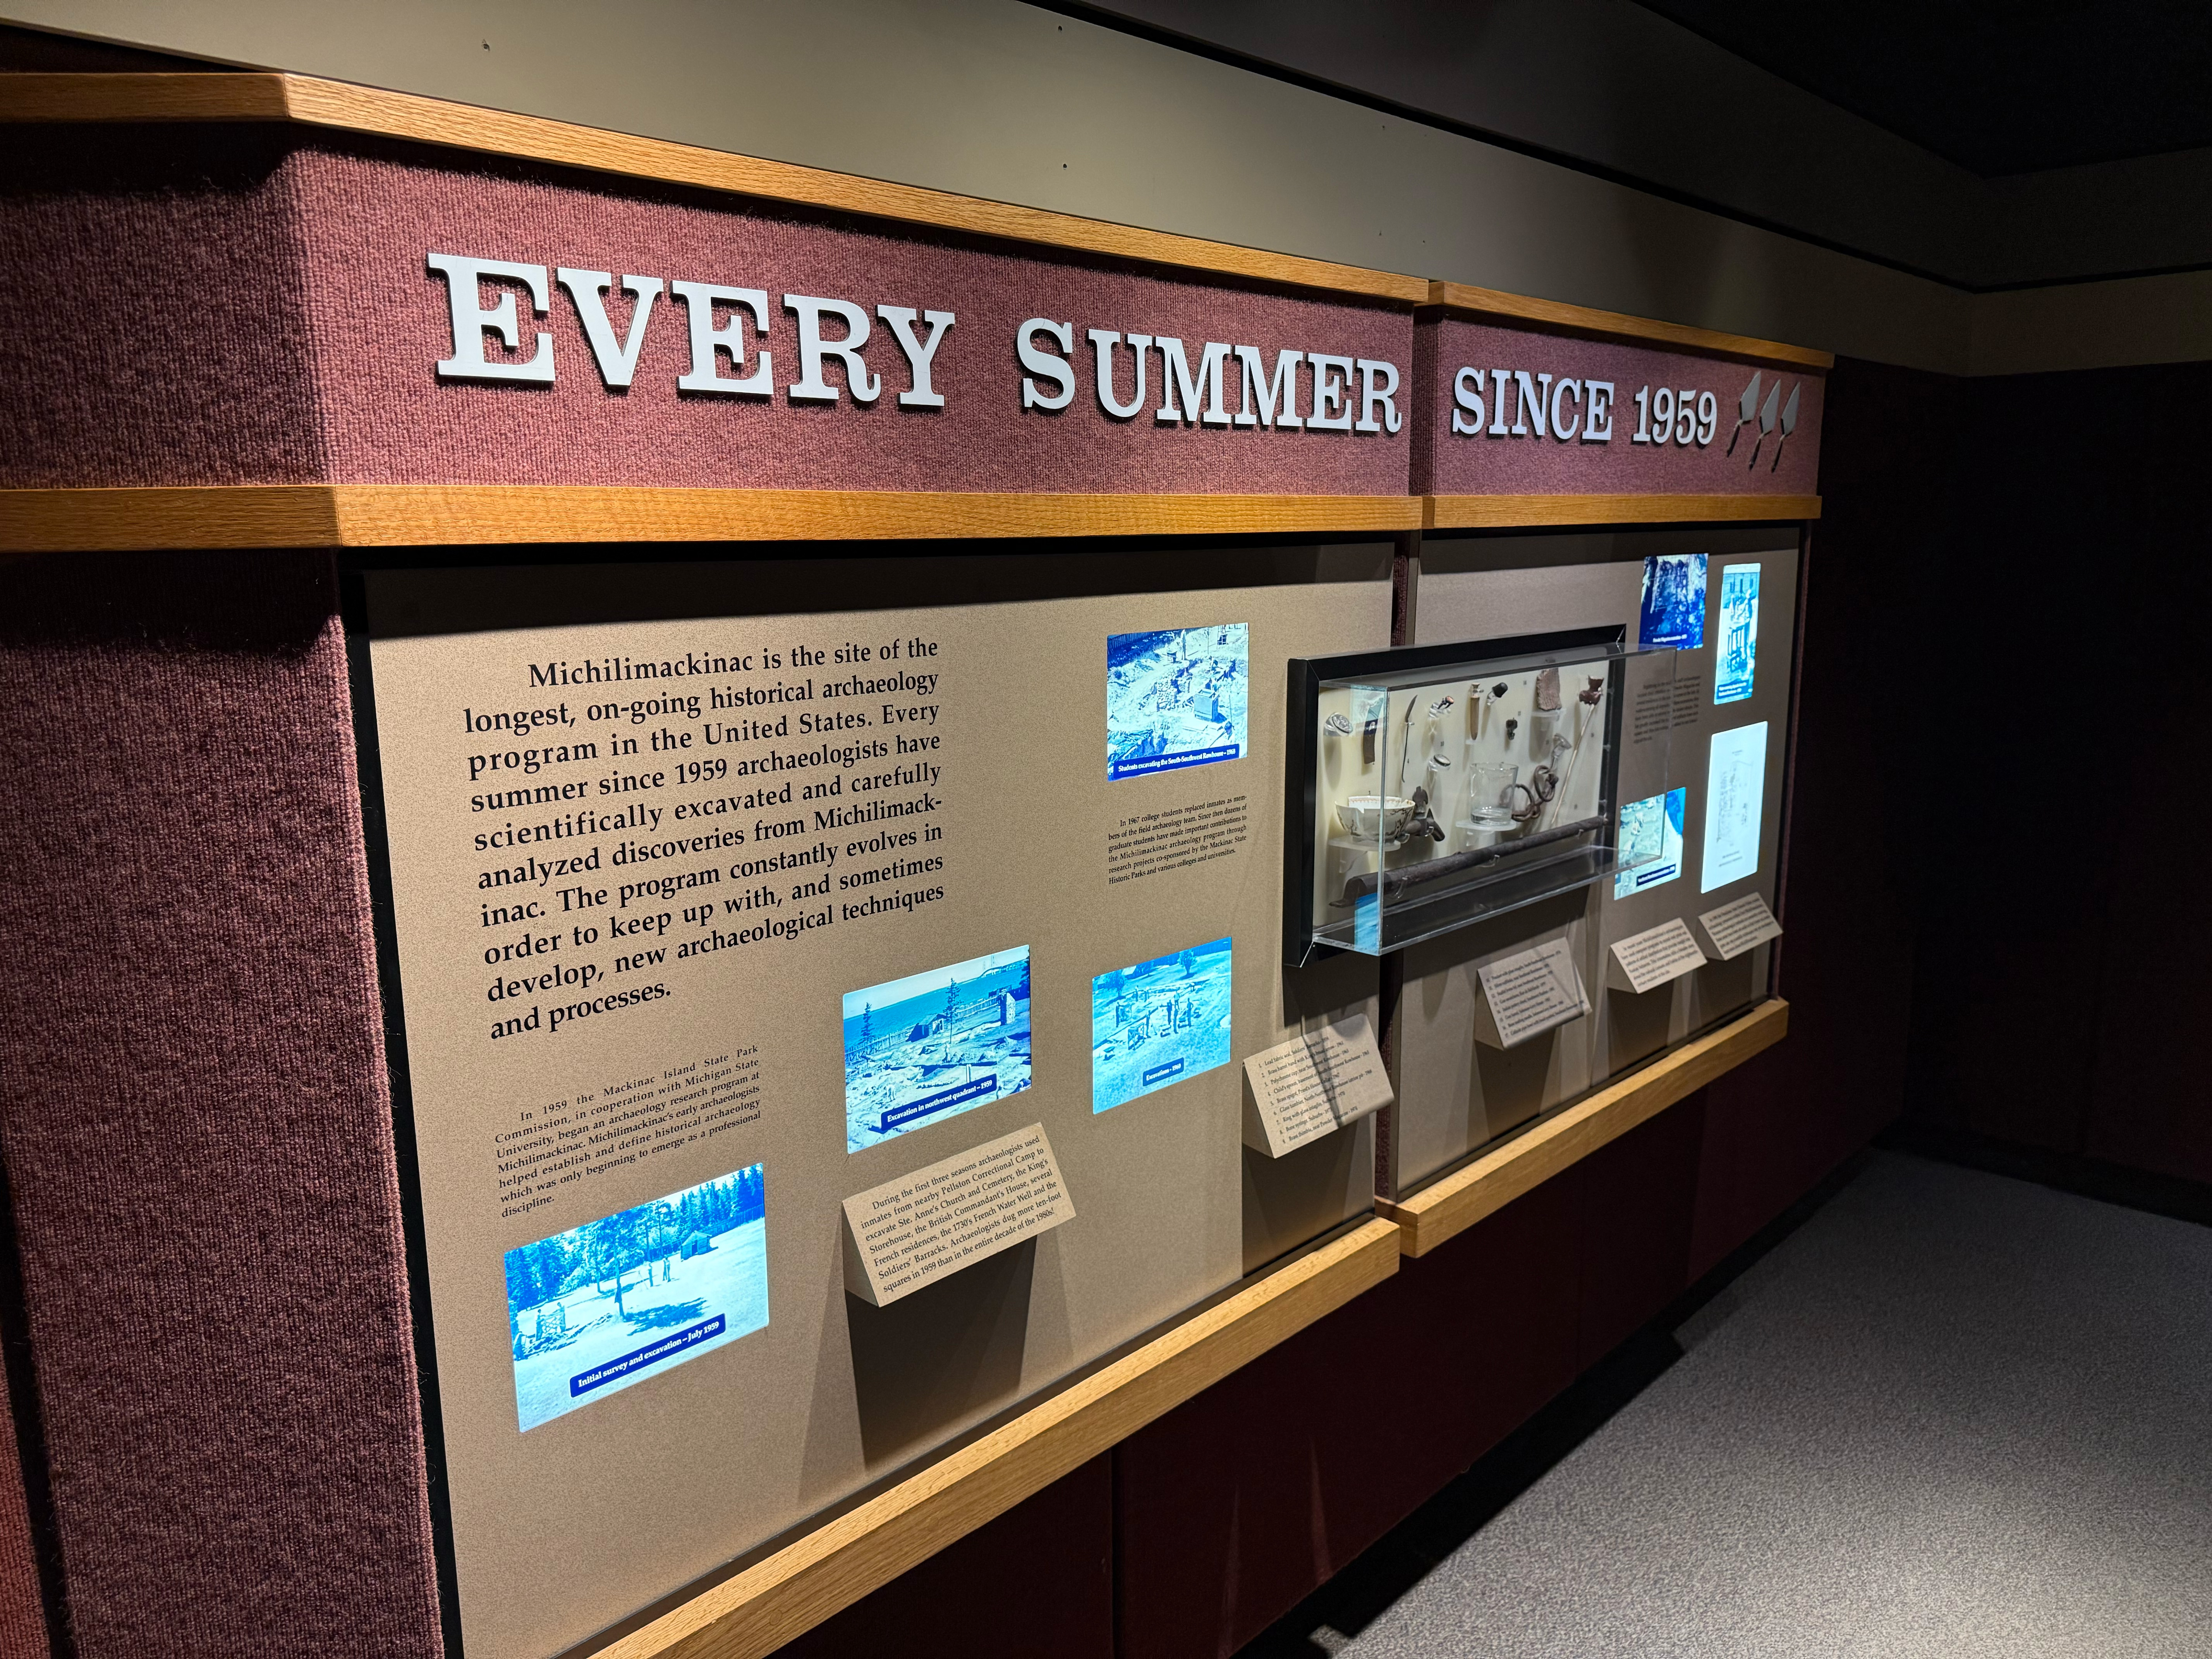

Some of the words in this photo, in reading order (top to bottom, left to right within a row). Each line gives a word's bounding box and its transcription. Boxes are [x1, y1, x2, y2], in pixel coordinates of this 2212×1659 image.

[427, 253, 956, 408] EVERY
[1017, 317, 1402, 433] SUMMER
[1453, 366, 1614, 440] SINCE
[1633, 385, 1717, 444] 1959
[528, 652, 753, 688] Michilimackinac
[763, 648, 781, 670] is
[791, 645, 825, 668] the
[834, 642, 871, 664] site
[879, 638, 900, 660] of
[908, 637, 938, 658] the
[463, 702, 576, 737] longest,
[587, 691, 701, 725] on-going
[709, 679, 814, 709] historical
[823, 670, 939, 698] archaeology
[467, 743, 598, 781] program
[611, 733, 639, 756] in
[651, 728, 692, 752] the
[703, 714, 789, 745] United
[799, 711, 872, 734] States.
[881, 704, 939, 725] Every
[471, 781, 588, 812] summer
[599, 770, 665, 795] since
[675, 758, 727, 785] 1959
[737, 740, 888, 776] archaeologists
[895, 734, 940, 754] have
[1118, 764, 1138, 772] Students
[1138, 760, 1161, 769] excavating
[474, 803, 663, 851] scientifically
[675, 782, 792, 820] excavated
[802, 774, 842, 800] and
[851, 761, 941, 792] carefully
[478, 847, 601, 890] analyzed
[612, 827, 745, 866] discoveries
[754, 819, 805, 842] from
[813, 792, 942, 831] Michilimack-
[1108, 855, 1118, 863] the
[1120, 844, 1168, 860] Michilimackinac
[1169, 836, 1202, 848] archaeology
[1203, 830, 1225, 842] program
[1226, 824, 1247, 835] through
[1128, 816, 1140, 825] 1967
[1141, 813, 1160, 822] college
[1161, 808, 1183, 818] students
[1184, 802, 1205, 814] replaced
[1206, 799, 1226, 808] inmates
[481, 902, 546, 927] inac.
[556, 886, 608, 912] The
[618, 868, 721, 909] program
[730, 842, 838, 879] constantly
[847, 831, 917, 857] evolves
[924, 823, 942, 842] in
[484, 933, 562, 965] order
[573, 926, 598, 946] to
[609, 912, 672, 939] keep
[682, 904, 713, 927] up
[723, 885, 782, 914] with,
[792, 872, 831, 900] and
[839, 856, 943, 890] sometimes
[488, 964, 604, 1002] develop,
[615, 948, 667, 973] new
[677, 904, 834, 959] archaeological
[842, 886, 944, 921] techniques
[491, 1006, 541, 1040] and
[548, 983, 671, 1033] processes.
[495, 1117, 571, 1143] Commission,
[575, 1111, 586, 1120] in
[591, 1091, 654, 1115] cooperation
[658, 1081, 681, 1094] with
[685, 1068, 732, 1087] Michigan
[735, 1060, 759, 1072] State
[496, 1136, 554, 1158] University,
[558, 1125, 589, 1140] began
[593, 1120, 605, 1129] an
[609, 1101, 666, 1124] archaeology
[670, 1087, 708, 1106] research
[711, 1076, 748, 1096] program
[751, 1071, 759, 1080] at
[520, 1111, 532, 1121] In
[542, 1100, 567, 1115] 1959
[577, 1094, 594, 1104] the
[603, 1076, 655, 1097] Mackinac
[664, 1062, 696, 1079] Island
[704, 1055, 728, 1067] State
[737, 1044, 758, 1065] Park
[887, 1107, 917, 1122] Excavation
[924, 1094, 952, 1109] northwest
[952, 1085, 976, 1101] quadrant
[981, 1079, 993, 1089] 1959
[498, 1141, 586, 1174] Michilimackinac.
[588, 1112, 673, 1145] Michilimackinac's
[675, 1104, 698, 1118] early
[700, 1085, 760, 1110] archaeologists
[499, 1168, 538, 1188] helped
[542, 1152, 591, 1175] establish
[595, 1144, 614, 1158] and
[618, 1134, 651, 1150] define
[655, 1116, 701, 1139] historical
[704, 1099, 760, 1122] archaeology
[500, 1186, 532, 1202] which
[536, 1179, 556, 1191] was
[560, 1170, 582, 1183] only
[586, 1154, 636, 1175] beginning
[639, 1150, 648, 1158] to
[651, 1138, 685, 1154] emerge
[688, 1133, 697, 1142] as
[709, 1110, 760, 1137] professional
[501, 1196, 555, 1218] discipline.
[860, 1212, 892, 1229] inmates
[894, 1203, 912, 1215] from
[914, 1191, 939, 1206] nearby
[941, 1178, 971, 1195] Pellston
[972, 1158, 1014, 1181] Correctional
[1015, 1152, 1035, 1163] Camp
[866, 1224, 896, 1241] excavate
[898, 1218, 912, 1227] Ste.
[915, 1205, 939, 1221] Anne's
[940, 1193, 966, 1209] Church
[968, 1186, 981, 1197] and
[982, 1174, 1015, 1190] Cemetery,
[1015, 1168, 1026, 1177] the
[1027, 1158, 1048, 1171] King's
[872, 1194, 900, 1210] During
[901, 1189, 913, 1198] the
[915, 1181, 930, 1192] first
[931, 1174, 949, 1185] three
[951, 1163, 977, 1178] seasons
[978, 1144, 1023, 1166] archaeologists
[1024, 1135, 1040, 1147] used
[578, 1370, 602, 1388] Initial
[603, 1361, 628, 1377] survey
[629, 1353, 643, 1366] and
[644, 1338, 682, 1359] excavation
[687, 1329, 703, 1342] July
[703, 1321, 719, 1334] 1959
